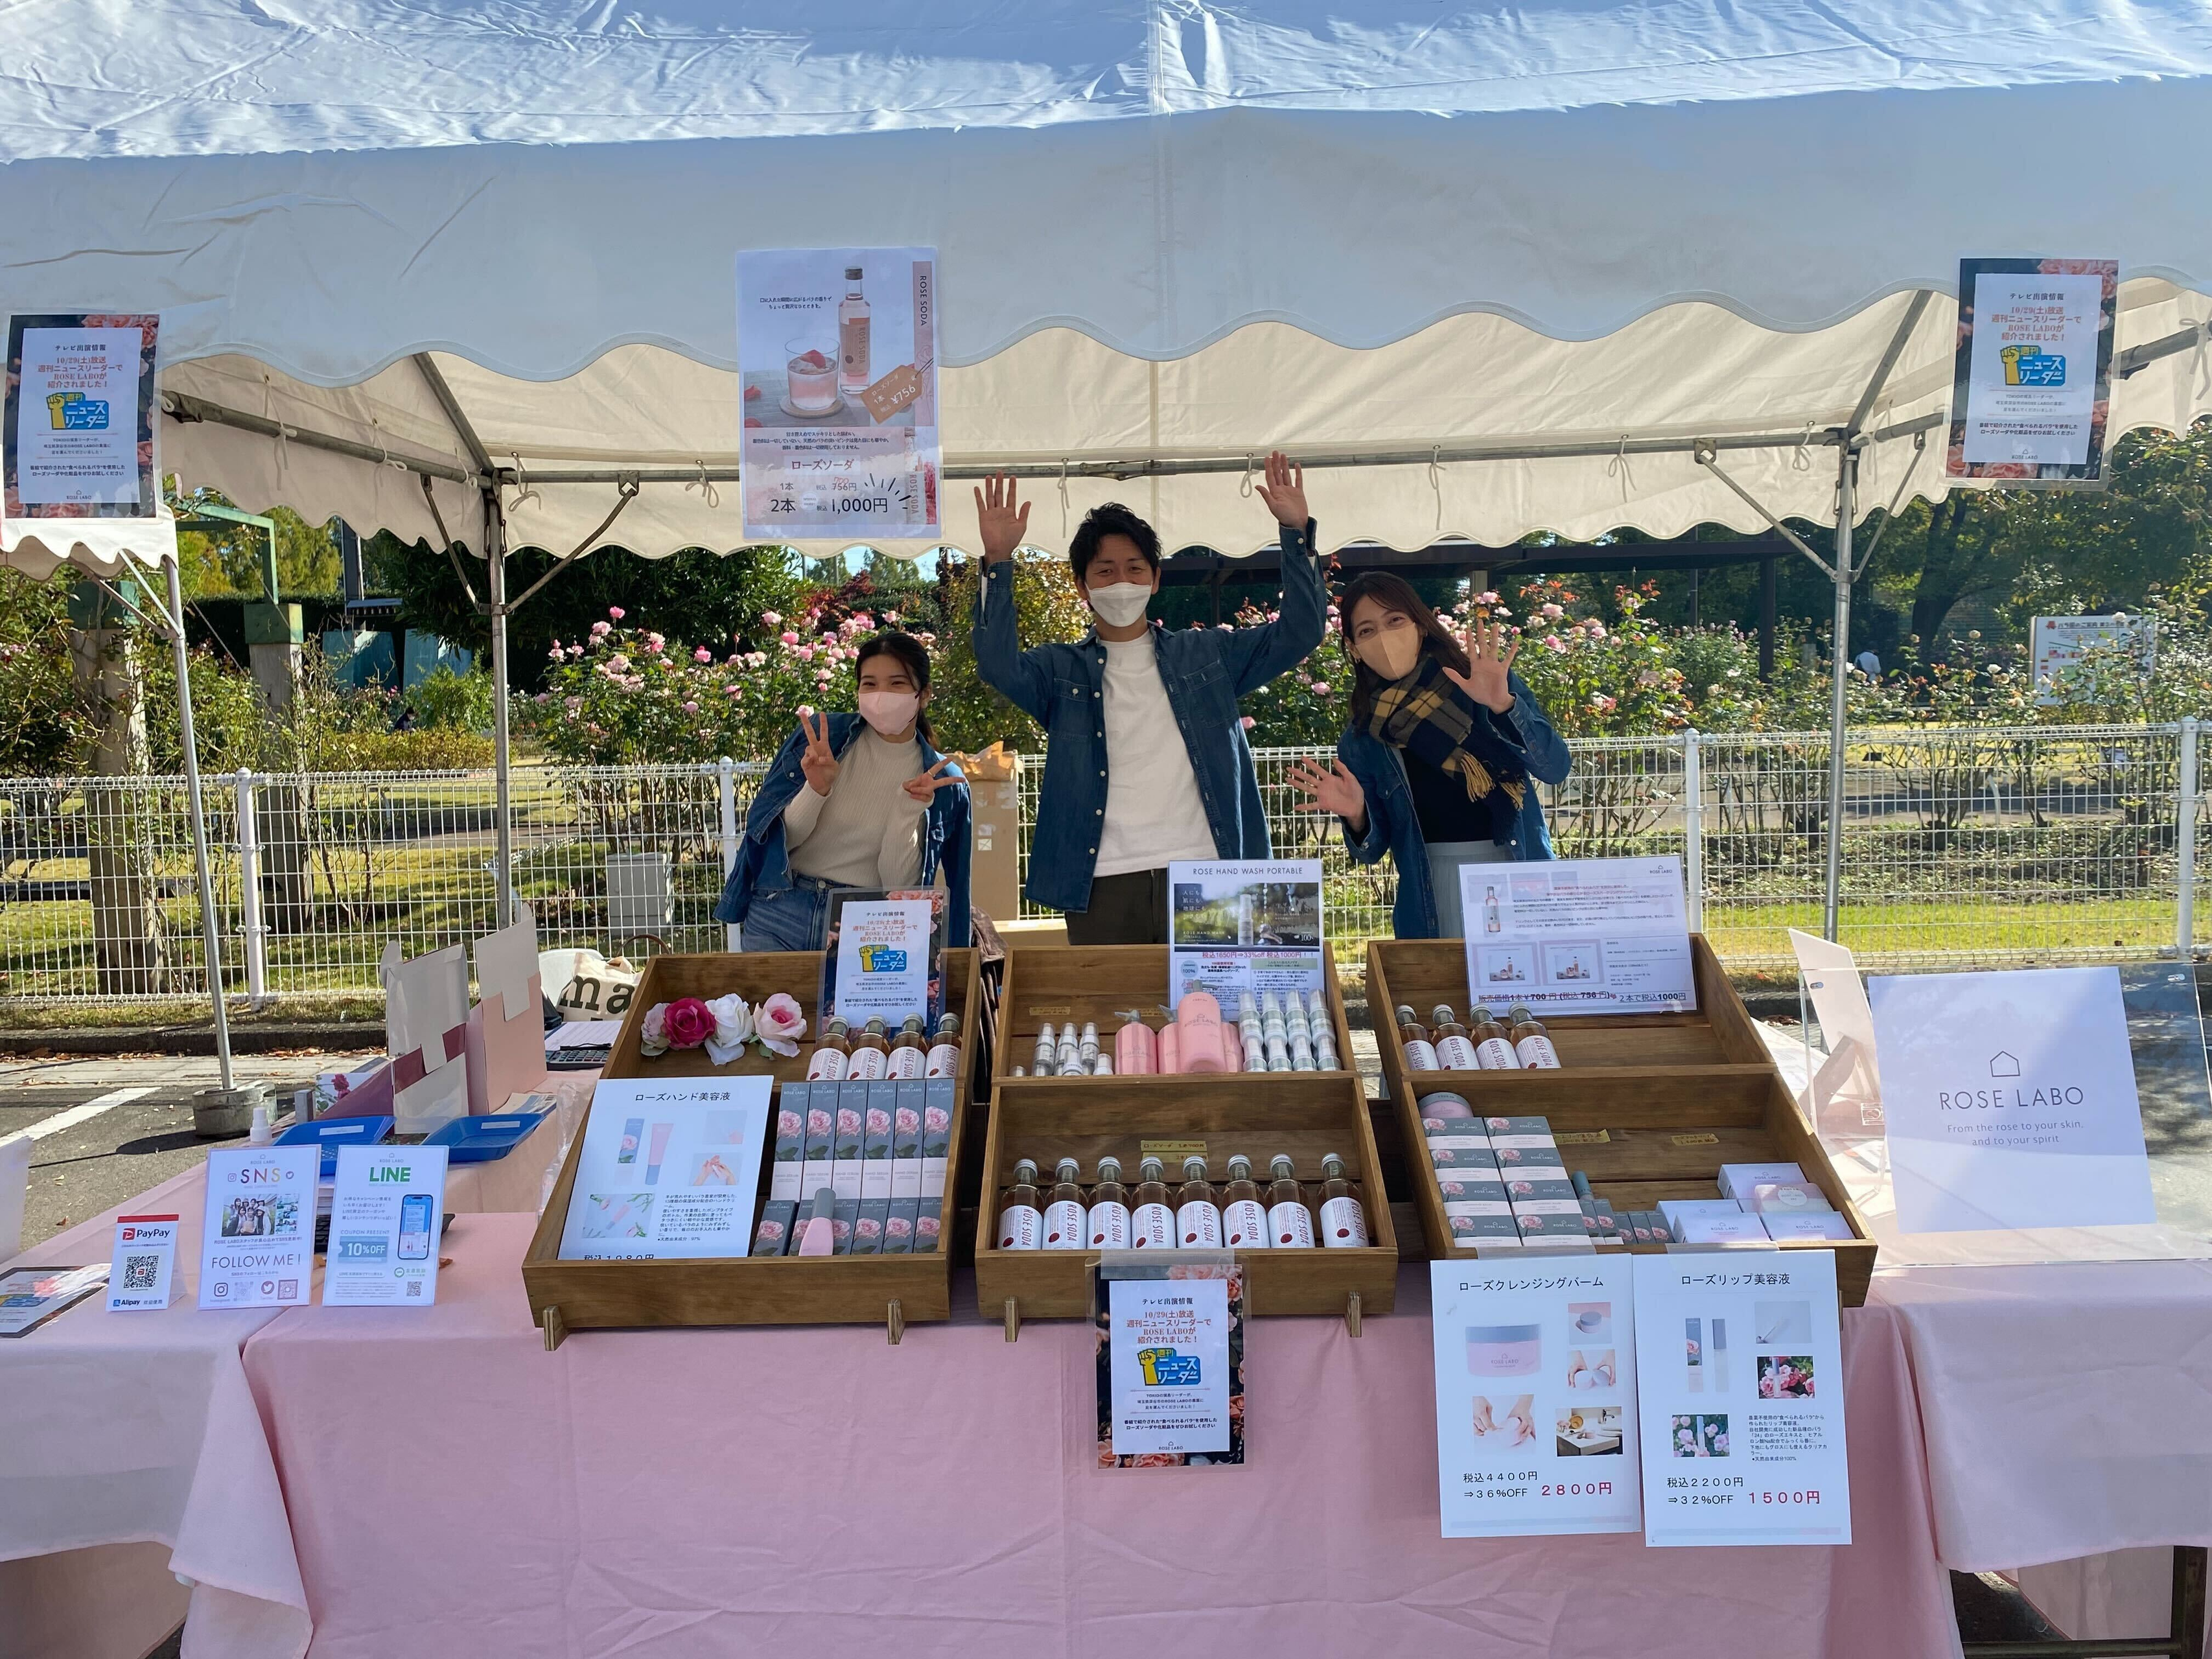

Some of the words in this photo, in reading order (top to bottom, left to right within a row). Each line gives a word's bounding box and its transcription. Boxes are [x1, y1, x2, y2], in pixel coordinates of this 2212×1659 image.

[1992, 315, 2081, 323] 週刊ニュースリーダーで
[2021, 358, 2063, 370] ニュース
[872, 373, 898, 396] ローズソーダ
[2020, 372, 2063, 384] リーダー
[874, 395, 885, 404] 1本
[891, 385, 915, 404] ¥756
[66, 402, 106, 414] ニュース
[66, 416, 106, 427] リーダー
[792, 459, 854, 470] ローズソーダ
[780, 482, 793, 491] 1本
[832, 483, 857, 491] 756円
[909, 474, 918, 493] ROSE
[771, 498, 796, 513] 2本
[832, 498, 887, 514] 1,000円
[911, 495, 919, 515] SODA
[1449, 1038, 1461, 1051] ROSE
[1489, 1041, 1500, 1054] ROSE
[1534, 1038, 1546, 1051] ROSE
[1540, 1052, 1553, 1066] SODA
[830, 1051, 840, 1063] ROSE
[869, 1050, 879, 1064] ROSE
[906, 1049, 914, 1062] ROSE
[948, 1047, 957, 1061] ROSE
[1454, 1052, 1466, 1066] SODA
[826, 1065, 837, 1080] SODA
[866, 1065, 876, 1080] SODA
[904, 1063, 914, 1078] SODA
[635, 1092, 731, 1102] ローズハンド美容液
[1940, 1089, 2004, 1110] ROSE
[2017, 1086, 2084, 1108] LABO
[1948, 1124, 1973, 1133] From
[1977, 1124, 1993, 1132] the
[2035, 1122, 2058, 1131] your
[1972, 1137, 1990, 1146] and
[2007, 1137, 2029, 1146] your
[2033, 1135, 2059, 1144] spirit
[240, 1168, 281, 1184] SNS
[369, 1167, 411, 1182] LINE
[1023, 1209, 1033, 1227] ROSE
[1067, 1204, 1077, 1222] ROSE
[1112, 1205, 1121, 1223] ROSE
[1152, 1207, 1161, 1224] ROSE
[1202, 1204, 1213, 1222] ROSE
[1244, 1203, 1255, 1222] ROSE
[1296, 1206, 1307, 1225] ROSE
[1351, 1201, 1362, 1220] ROSE
[137, 1229, 170, 1238] PayPay
[1021, 1228, 1032, 1246] SODA
[1067, 1224, 1077, 1242] SODA
[1112, 1224, 1122, 1242] SODA
[1152, 1225, 1164, 1244] SODA
[1204, 1224, 1215, 1242] SODA
[1248, 1222, 1259, 1240] SODA
[1299, 1226, 1309, 1244] SODA
[1354, 1221, 1366, 1241] SODA
[212, 1255, 270, 1268] FOLLOW
[1460, 1276, 1603, 1292] ローズクレンジングバーム
[1681, 1273, 1791, 1286] ローズリップ美容液
[1126, 1319, 1211, 1327] 週刊ニュースリーダーで
[1159, 1358, 1198, 1371] ニュース
[1158, 1371, 1198, 1384] リーダー
[1463, 1470, 1538, 1483] 税込4400円
[1668, 1476, 1743, 1489] 税込2200円
[1541, 1482, 1612, 1496] 2800円
[1749, 1491, 1821, 1504] 1500円
